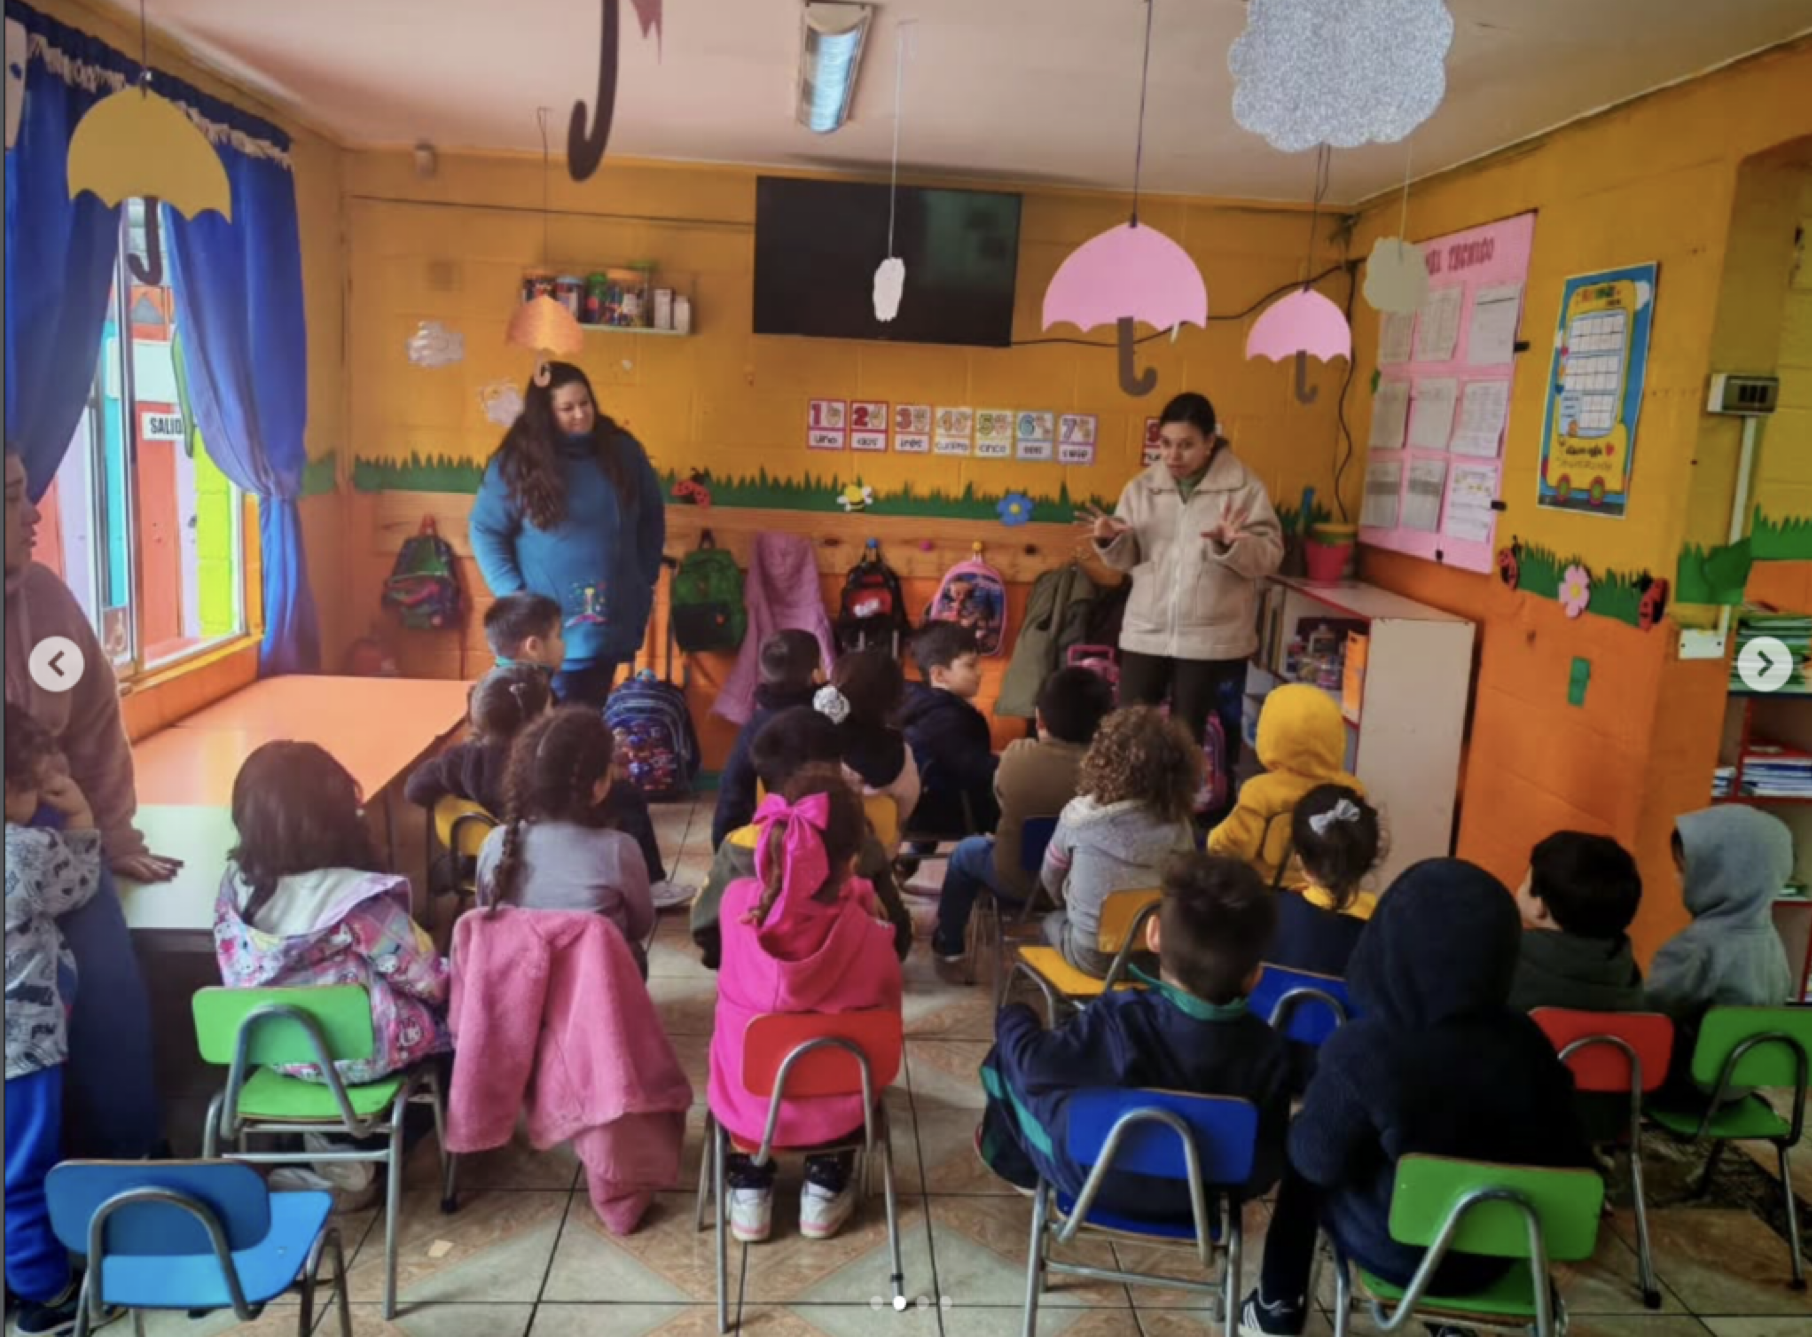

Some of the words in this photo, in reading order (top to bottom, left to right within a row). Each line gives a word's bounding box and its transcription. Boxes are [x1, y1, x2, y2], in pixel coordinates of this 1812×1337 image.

[150, 416, 186, 435] SALID
[811, 403, 821, 426] 1
[854, 405, 869, 427] 2
[897, 407, 912, 430] 3
[978, 413, 994, 436] 5
[1019, 414, 1035, 437] 6
[1062, 418, 1078, 442] 7
